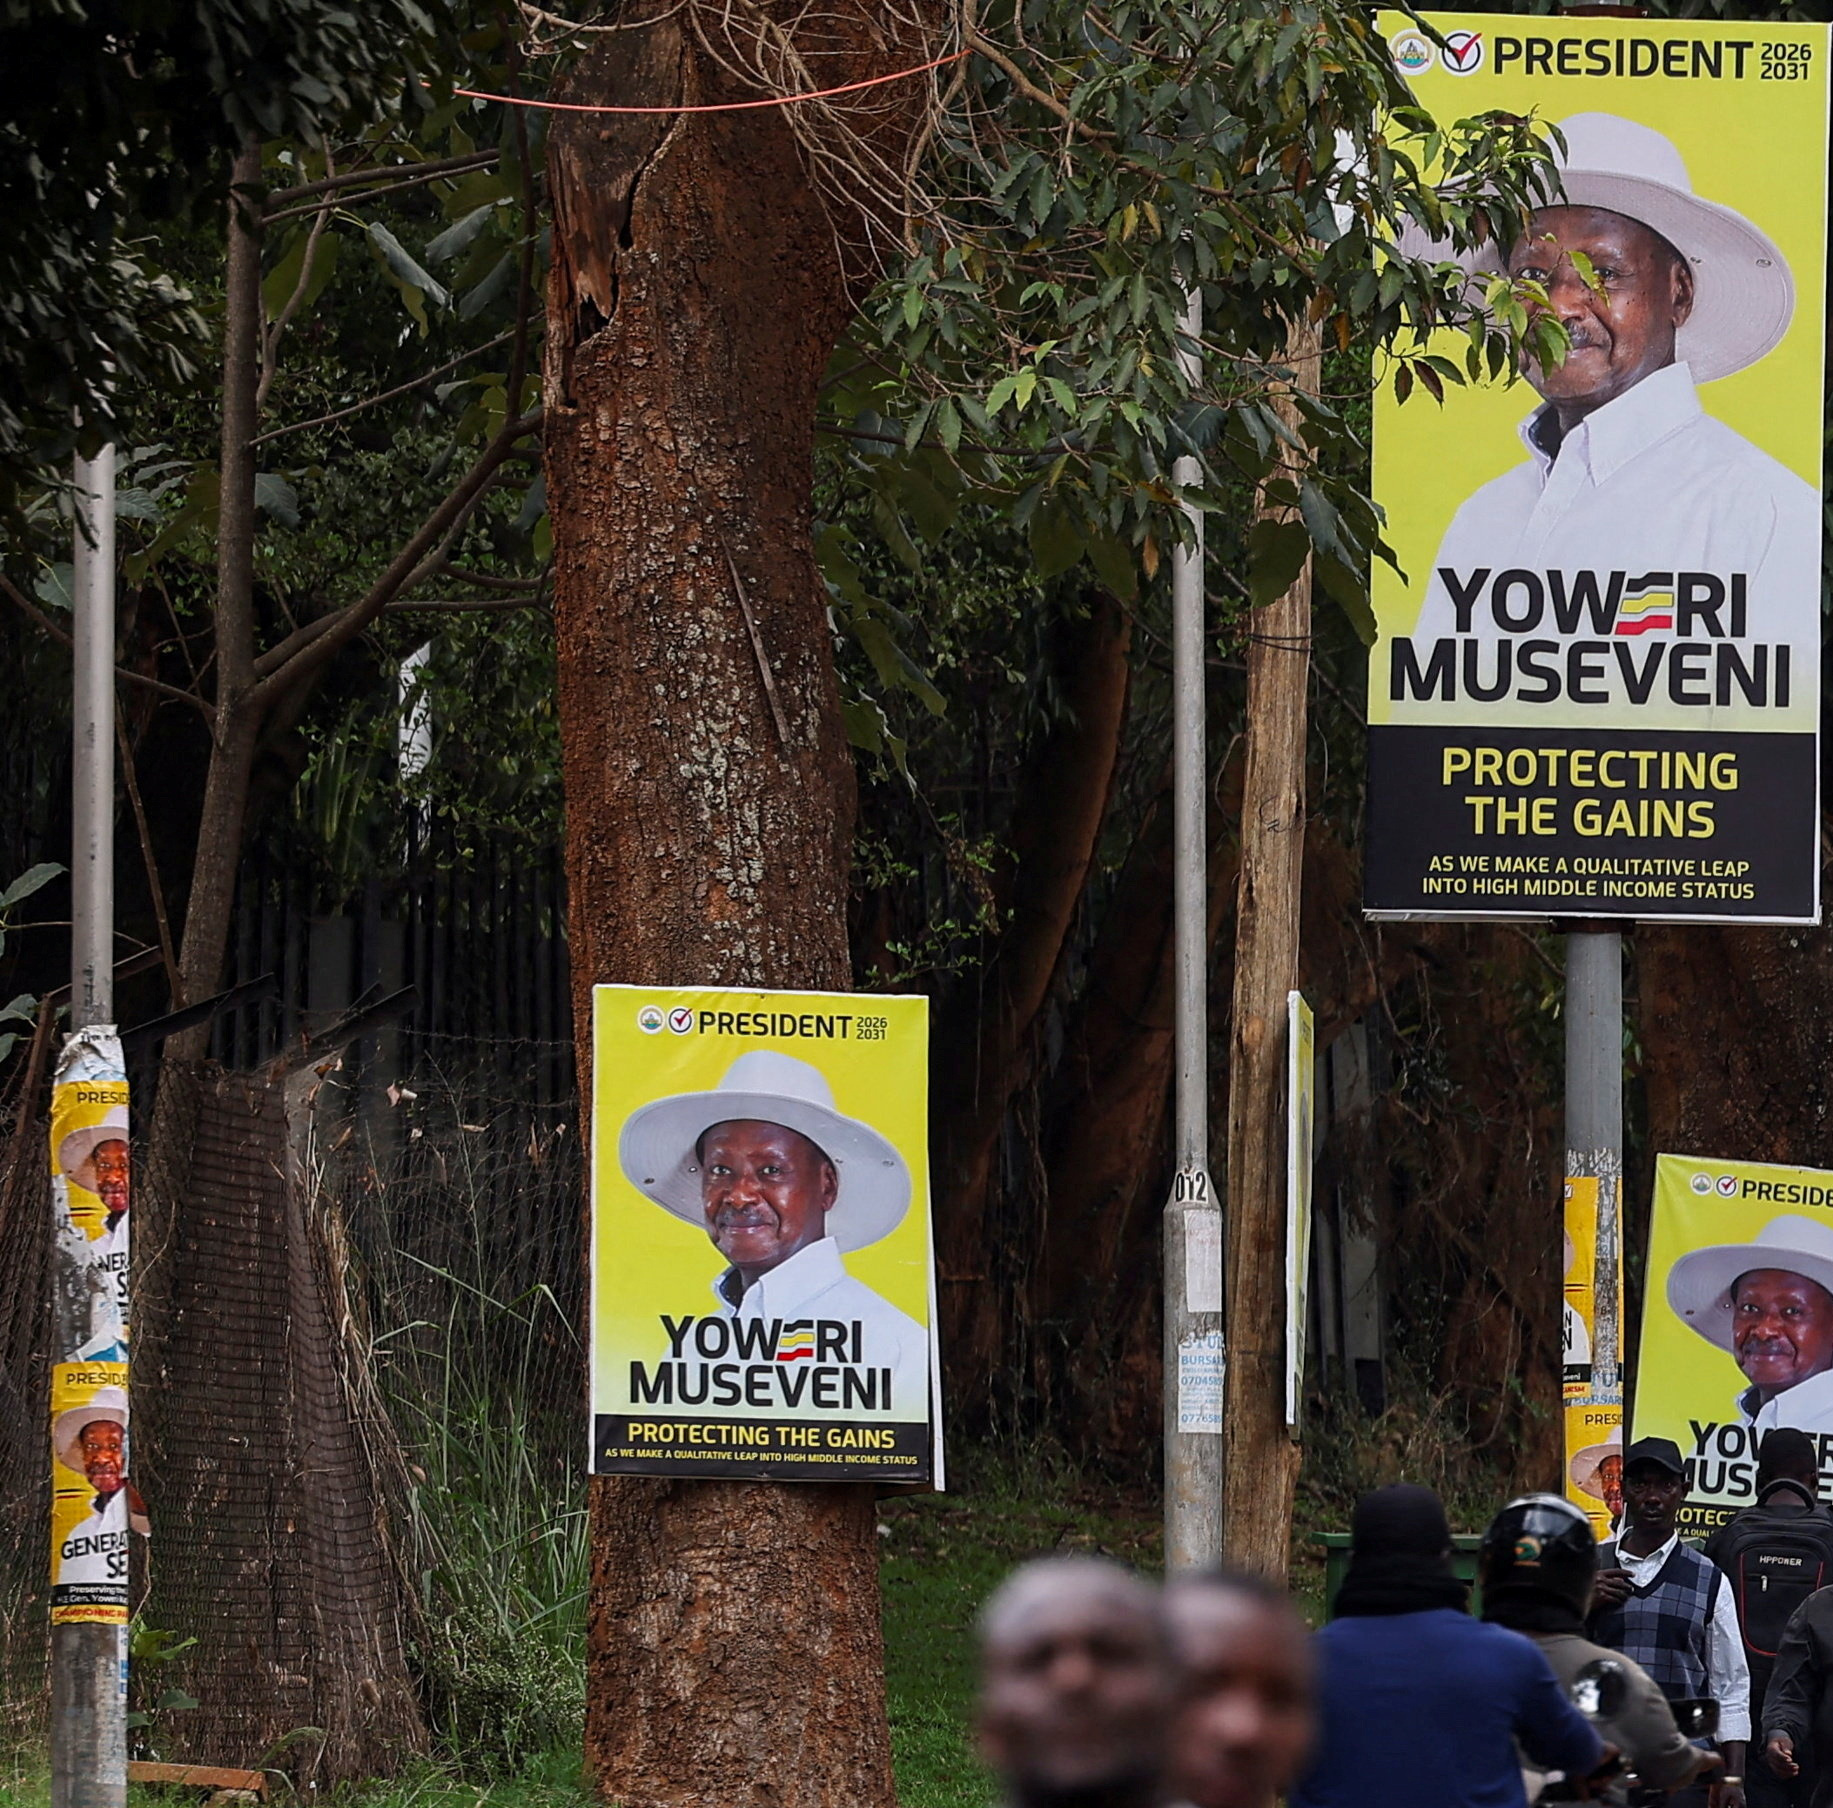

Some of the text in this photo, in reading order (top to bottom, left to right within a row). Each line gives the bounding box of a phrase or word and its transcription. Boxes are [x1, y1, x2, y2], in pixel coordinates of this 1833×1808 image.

[1494, 37, 1812, 78] PRESIDENT 2026
[1760, 62, 1809, 80] 2031
[1437, 568, 1746, 637] YOWERI
[1390, 637, 1790, 707] MUSEVENI
[1442, 747, 1739, 790] PROTECTING
[1465, 796, 1714, 838] THE GAINS
[1429, 856, 1749, 877] AS WE MAKE A QUALITATIVE LEAP
[1423, 878, 1754, 899] INTO HIGH MIDDLE INCOME STATUS
[700, 1011, 888, 1039] PRESIDENT 2026
[856, 1028, 886, 1040] 2031
[660, 1315, 862, 1363] YOWERI
[630, 1361, 892, 1410] MUSEVENI
[628, 1423, 895, 1449] PROTECTING THE GAINS
[606, 1449, 917, 1465] AS WE MAKE A QUALITATIVE LEAP INTO HIGH MIDDLE INCOME STATUS
[69, 1586, 115, 1595] Preserving
